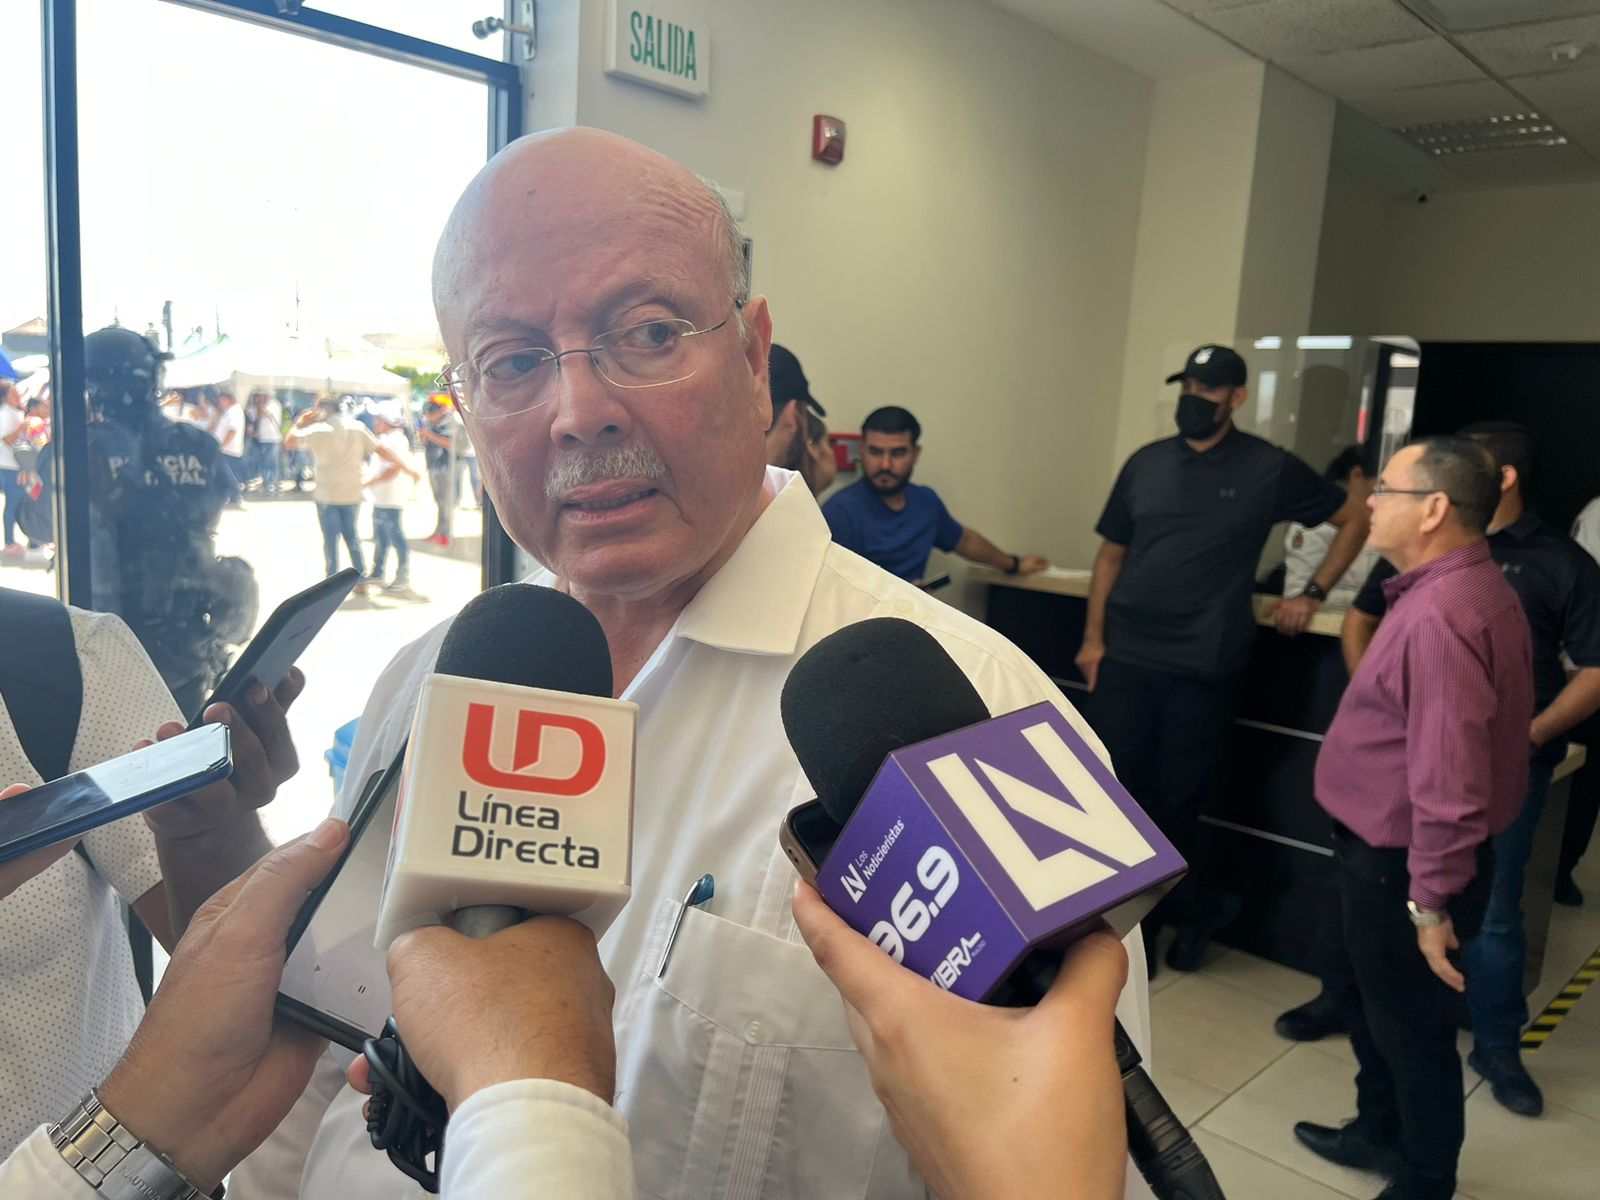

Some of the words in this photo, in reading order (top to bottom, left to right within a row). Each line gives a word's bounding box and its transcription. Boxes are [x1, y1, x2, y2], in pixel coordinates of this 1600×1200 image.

[629, 10, 697, 81] SALIDA
[457, 790, 560, 831] Línea
[451, 824, 600, 869] Directa
[855, 849, 869, 868] Los
[862, 819, 905, 881] Noticieristas
